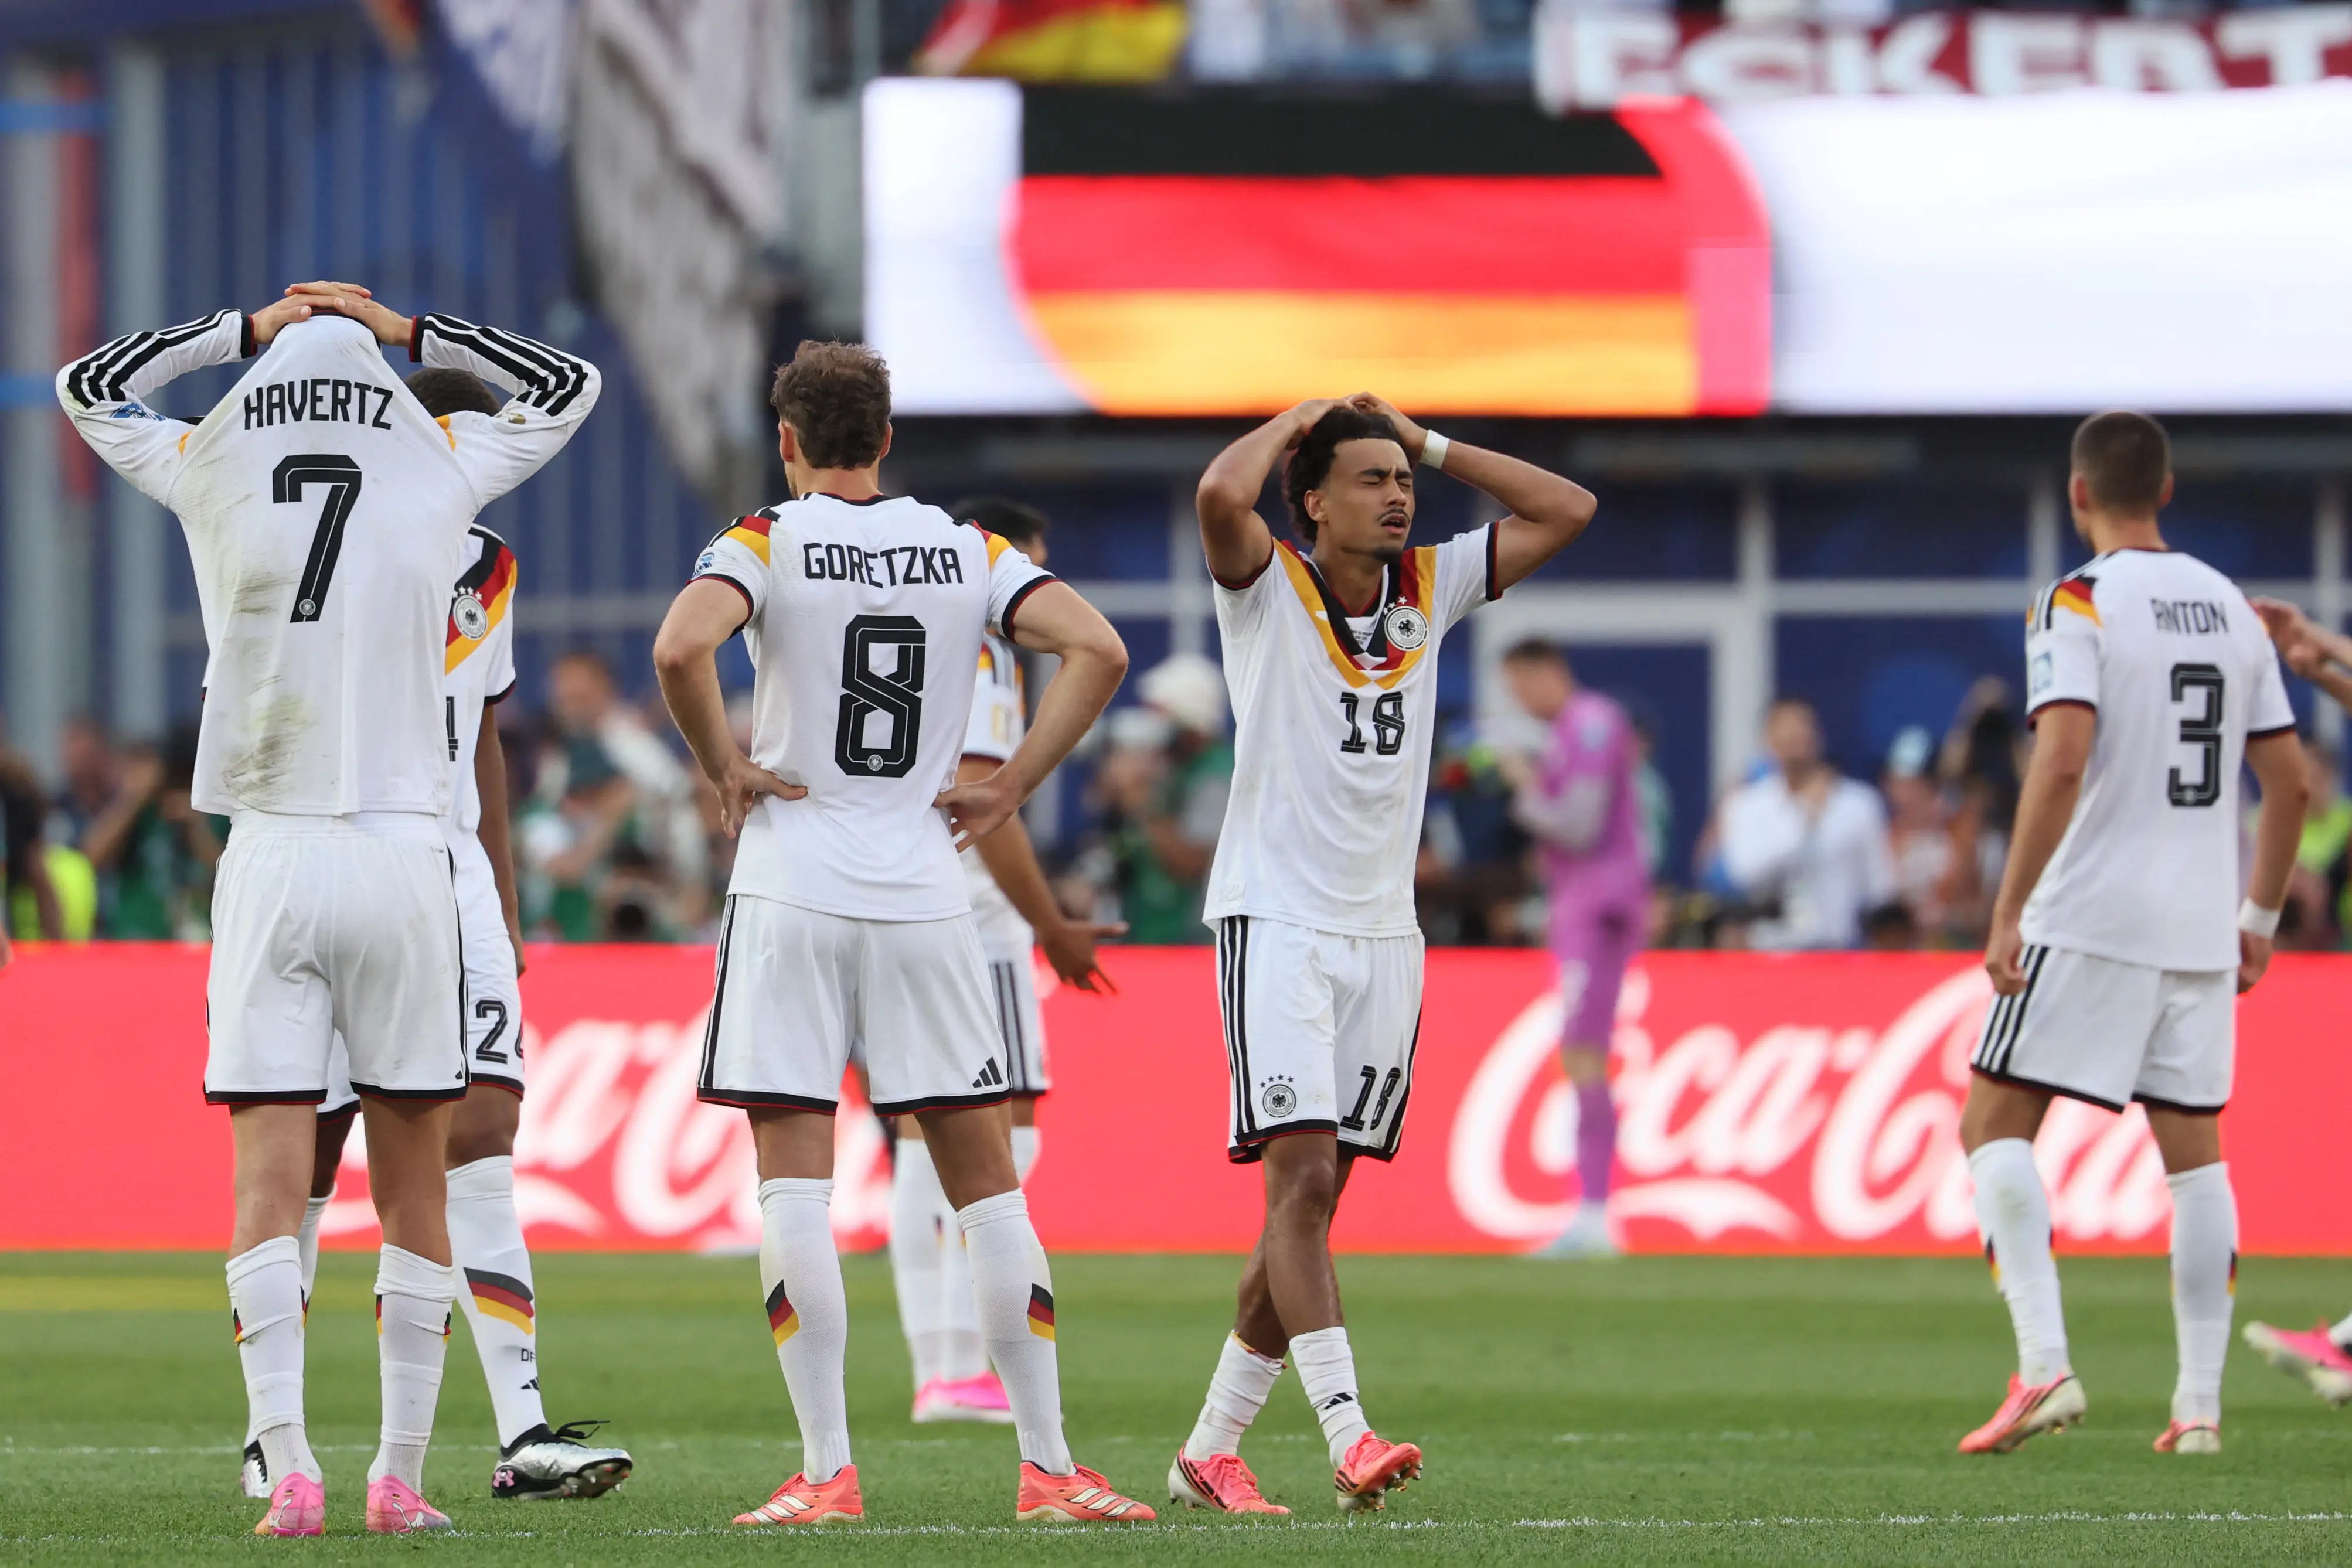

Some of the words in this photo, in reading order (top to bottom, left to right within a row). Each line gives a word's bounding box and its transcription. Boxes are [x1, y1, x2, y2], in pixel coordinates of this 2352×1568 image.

[244, 379, 393, 430] HAVERTZ
[273, 454, 362, 623] 7
[803, 542, 964, 589] GORETZKA
[2151, 598, 2229, 633] ANTON
[835, 614, 927, 778] 8
[1340, 691, 1406, 755] 18
[2167, 663, 2225, 807] 3
[476, 1000, 523, 1065] 2
[1340, 1065, 1401, 1131] 18
